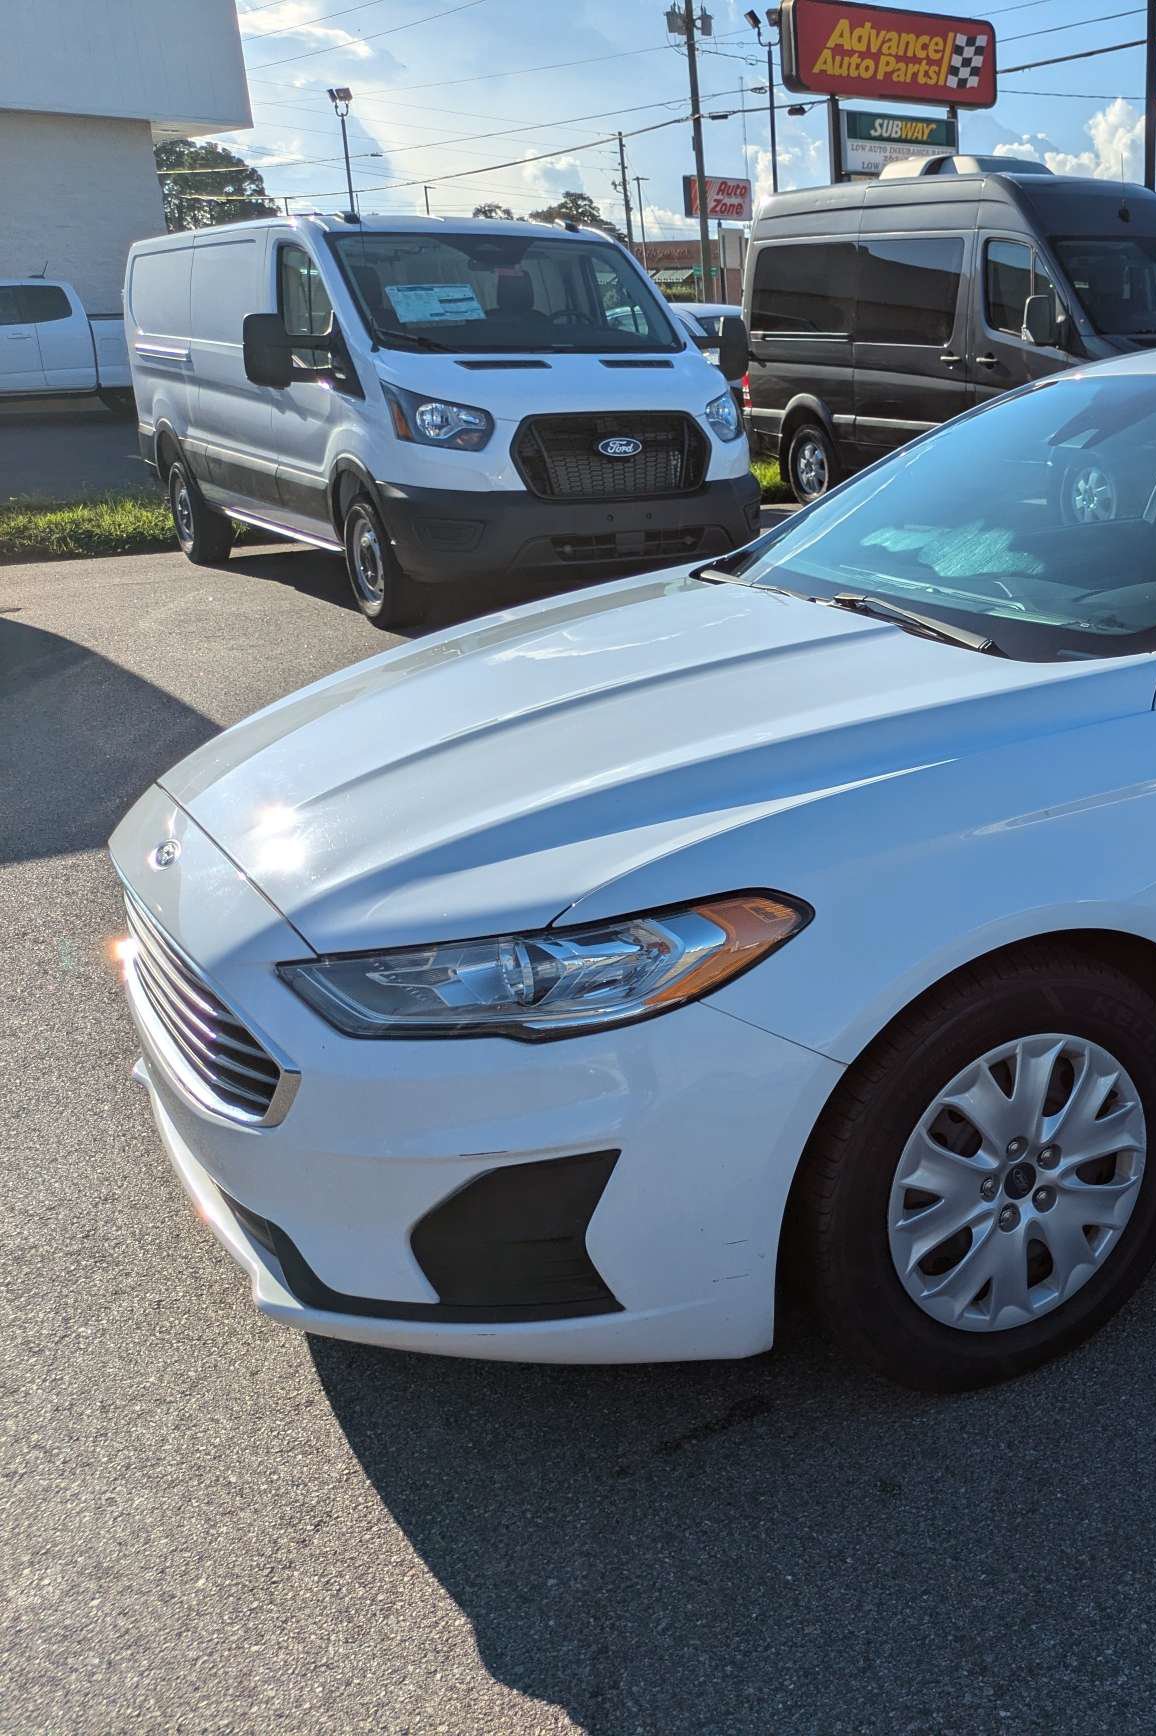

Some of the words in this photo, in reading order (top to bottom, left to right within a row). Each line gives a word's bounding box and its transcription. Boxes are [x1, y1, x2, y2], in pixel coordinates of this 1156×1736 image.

[826, 18, 944, 60] Advance
[812, 48, 875, 79] Auto
[876, 54, 938, 86] Parts
[870, 119, 936, 140] SUBWAY
[851, 143, 866, 152] LOW
[868, 144, 888, 154] AUTO
[716, 180, 748, 198] Auto
[709, 198, 744, 215] Zone
[607, 440, 634, 453] Ford
